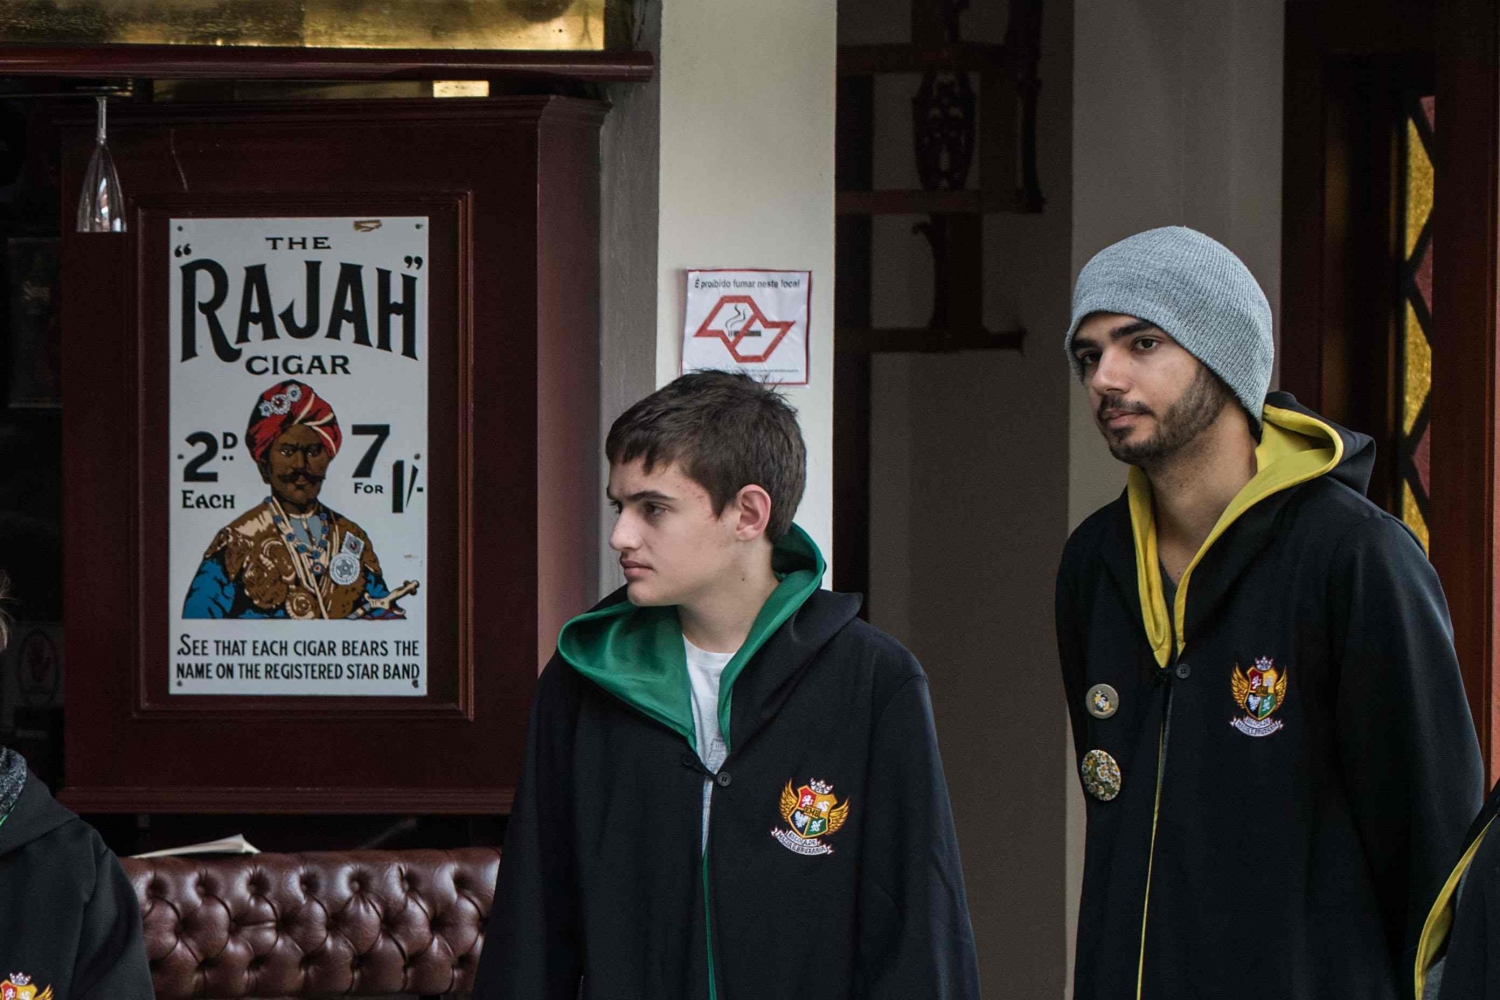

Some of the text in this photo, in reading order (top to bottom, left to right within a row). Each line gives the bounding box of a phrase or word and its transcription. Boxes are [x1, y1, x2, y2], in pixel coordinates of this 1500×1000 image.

[265, 236, 332, 250] THE
[701, 279, 731, 289] proibido
[733, 279, 756, 288] fumar
[780, 279, 800, 288] local
[245, 355, 351, 375] CIGAR
[351, 424, 390, 478] 7
[181, 490, 236, 509] EACH
[177, 634, 419, 656] SEE THAT EACH CIGAR BEARS THE
[176, 663, 420, 680] NAME ON THE REGISTERED STAR BAND
